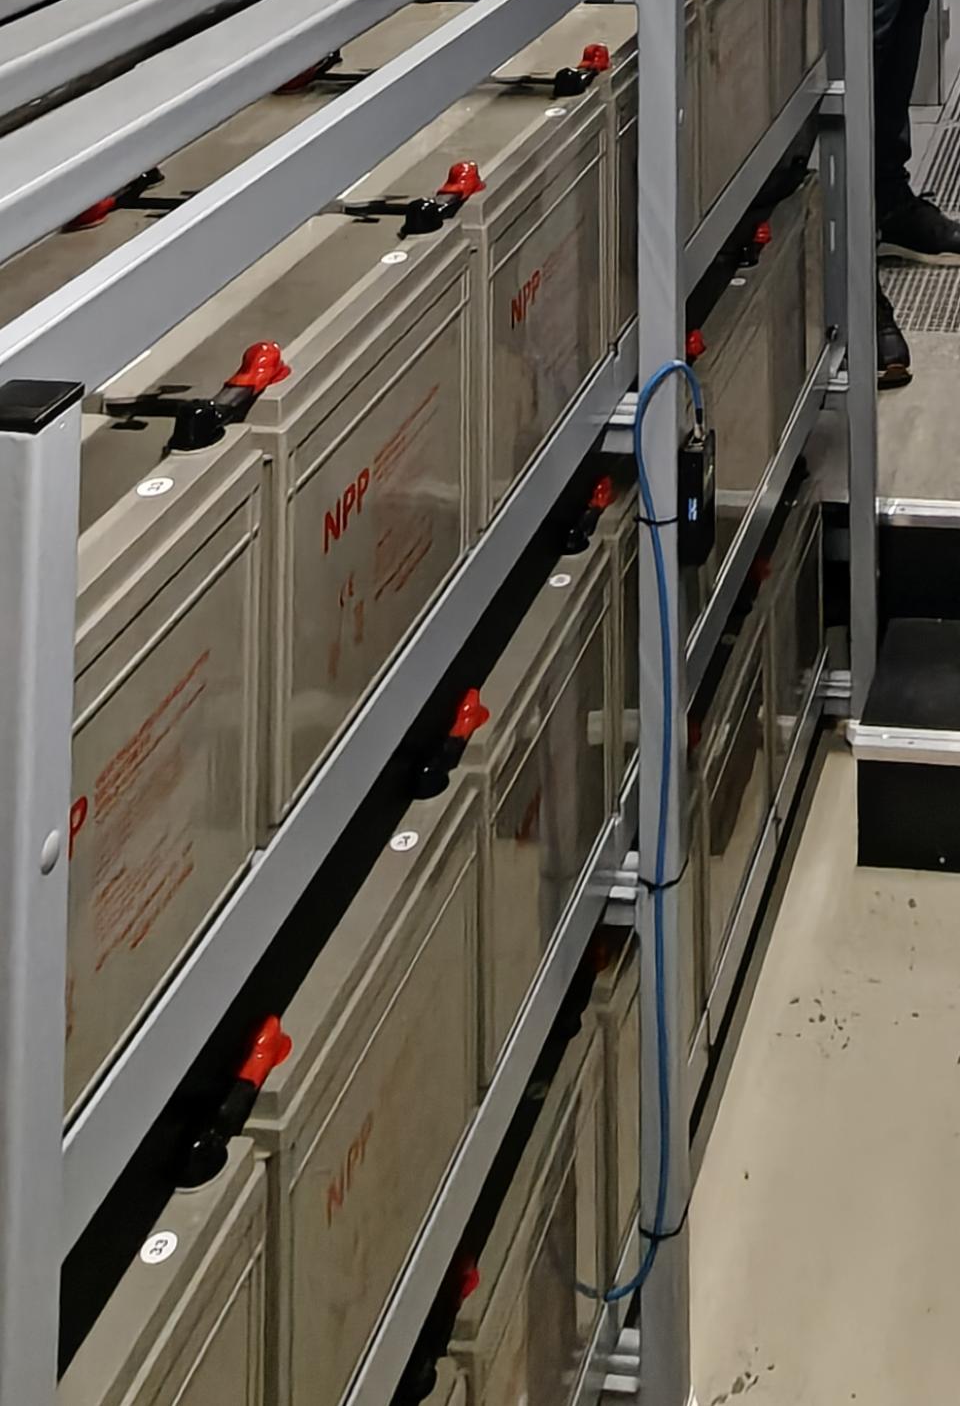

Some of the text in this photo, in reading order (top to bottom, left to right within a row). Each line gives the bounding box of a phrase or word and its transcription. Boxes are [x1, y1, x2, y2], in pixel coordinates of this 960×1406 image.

[511, 269, 541, 331] NPP
[323, 467, 370, 554] NPP
[326, 1110, 374, 1229] NPP
